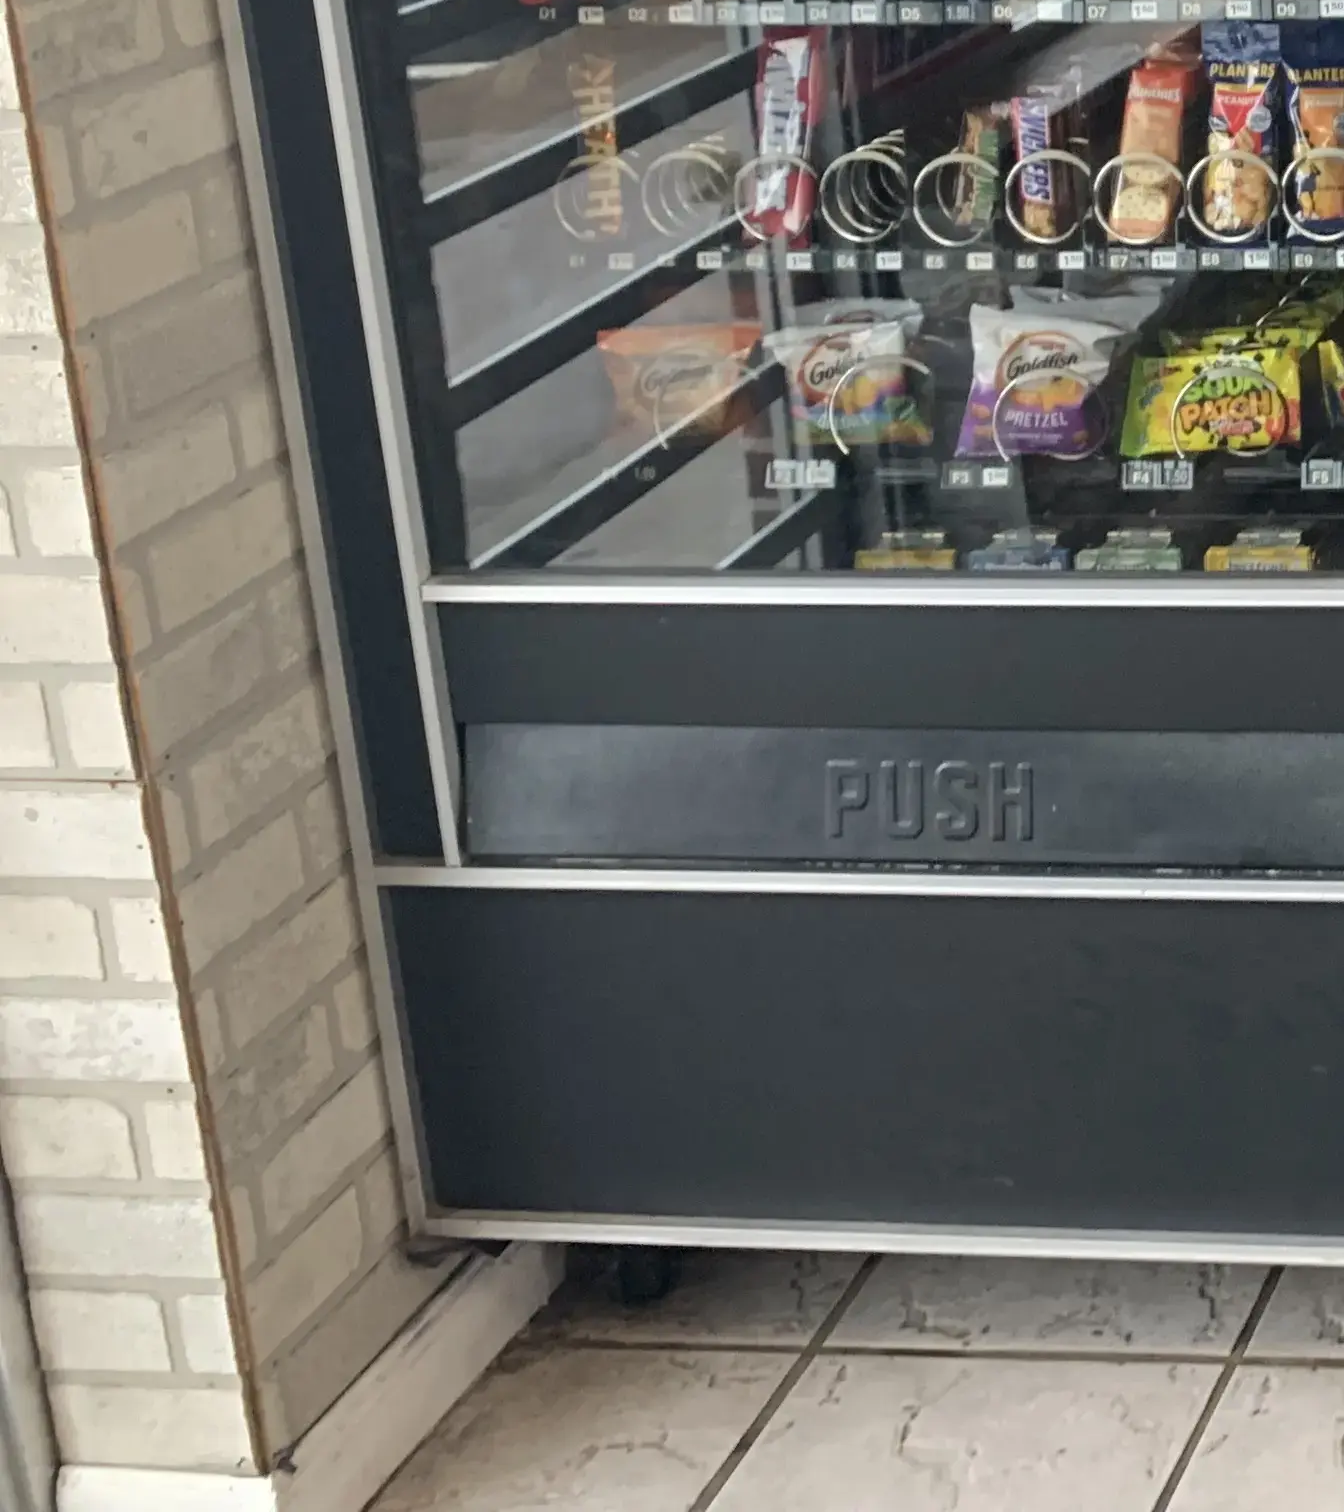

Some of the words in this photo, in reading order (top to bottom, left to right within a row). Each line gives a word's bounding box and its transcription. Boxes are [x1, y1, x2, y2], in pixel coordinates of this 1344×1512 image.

[901, 7, 919, 20] D5
[1088, 3, 1107, 18] D7
[1276, 2, 1296, 16] D9
[1209, 62, 1276, 78] PLANTERS
[1110, 256, 1128, 268] E7
[1007, 352, 1078, 380] Goldfish
[1005, 410, 1068, 428] PRETZEL
[1179, 389, 1273, 434] PATCH
[1131, 472, 1150, 484] F4
[825, 759, 1034, 842] PUSH
